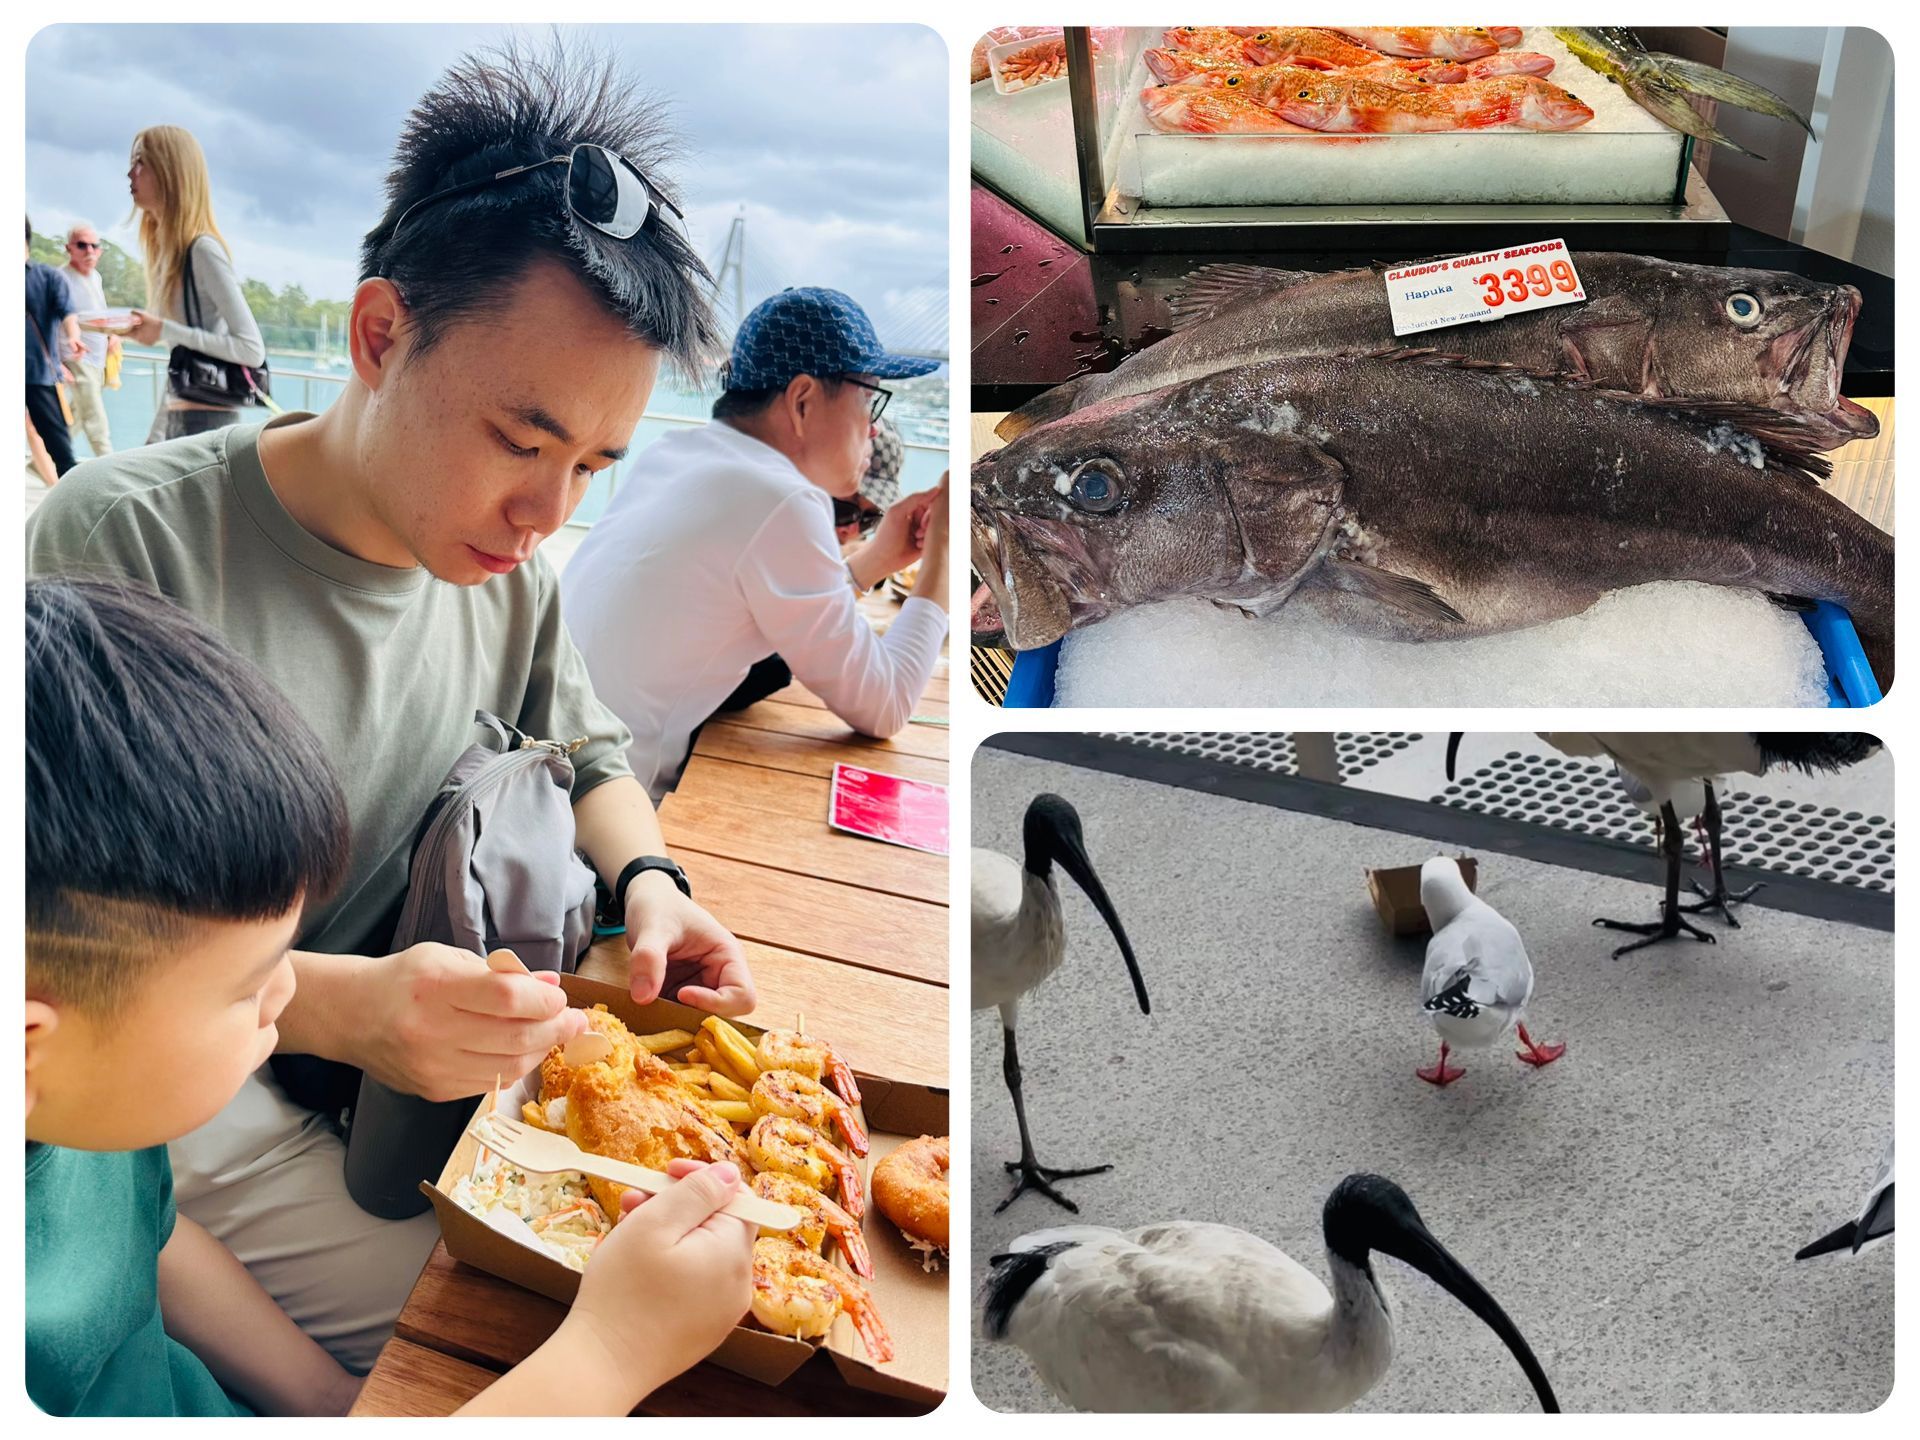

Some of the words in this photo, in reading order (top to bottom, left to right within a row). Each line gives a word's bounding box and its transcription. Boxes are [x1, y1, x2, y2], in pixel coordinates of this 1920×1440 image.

[1388, 262, 1449, 281] CLAUDIO'S
[1452, 253, 1500, 269] QUALITY
[1503, 241, 1563, 259] SEAFOODS
[1405, 284, 1453, 301] Hapuka
[1440, 315, 1456, 324] New
[1459, 308, 1492, 320] Zealand
